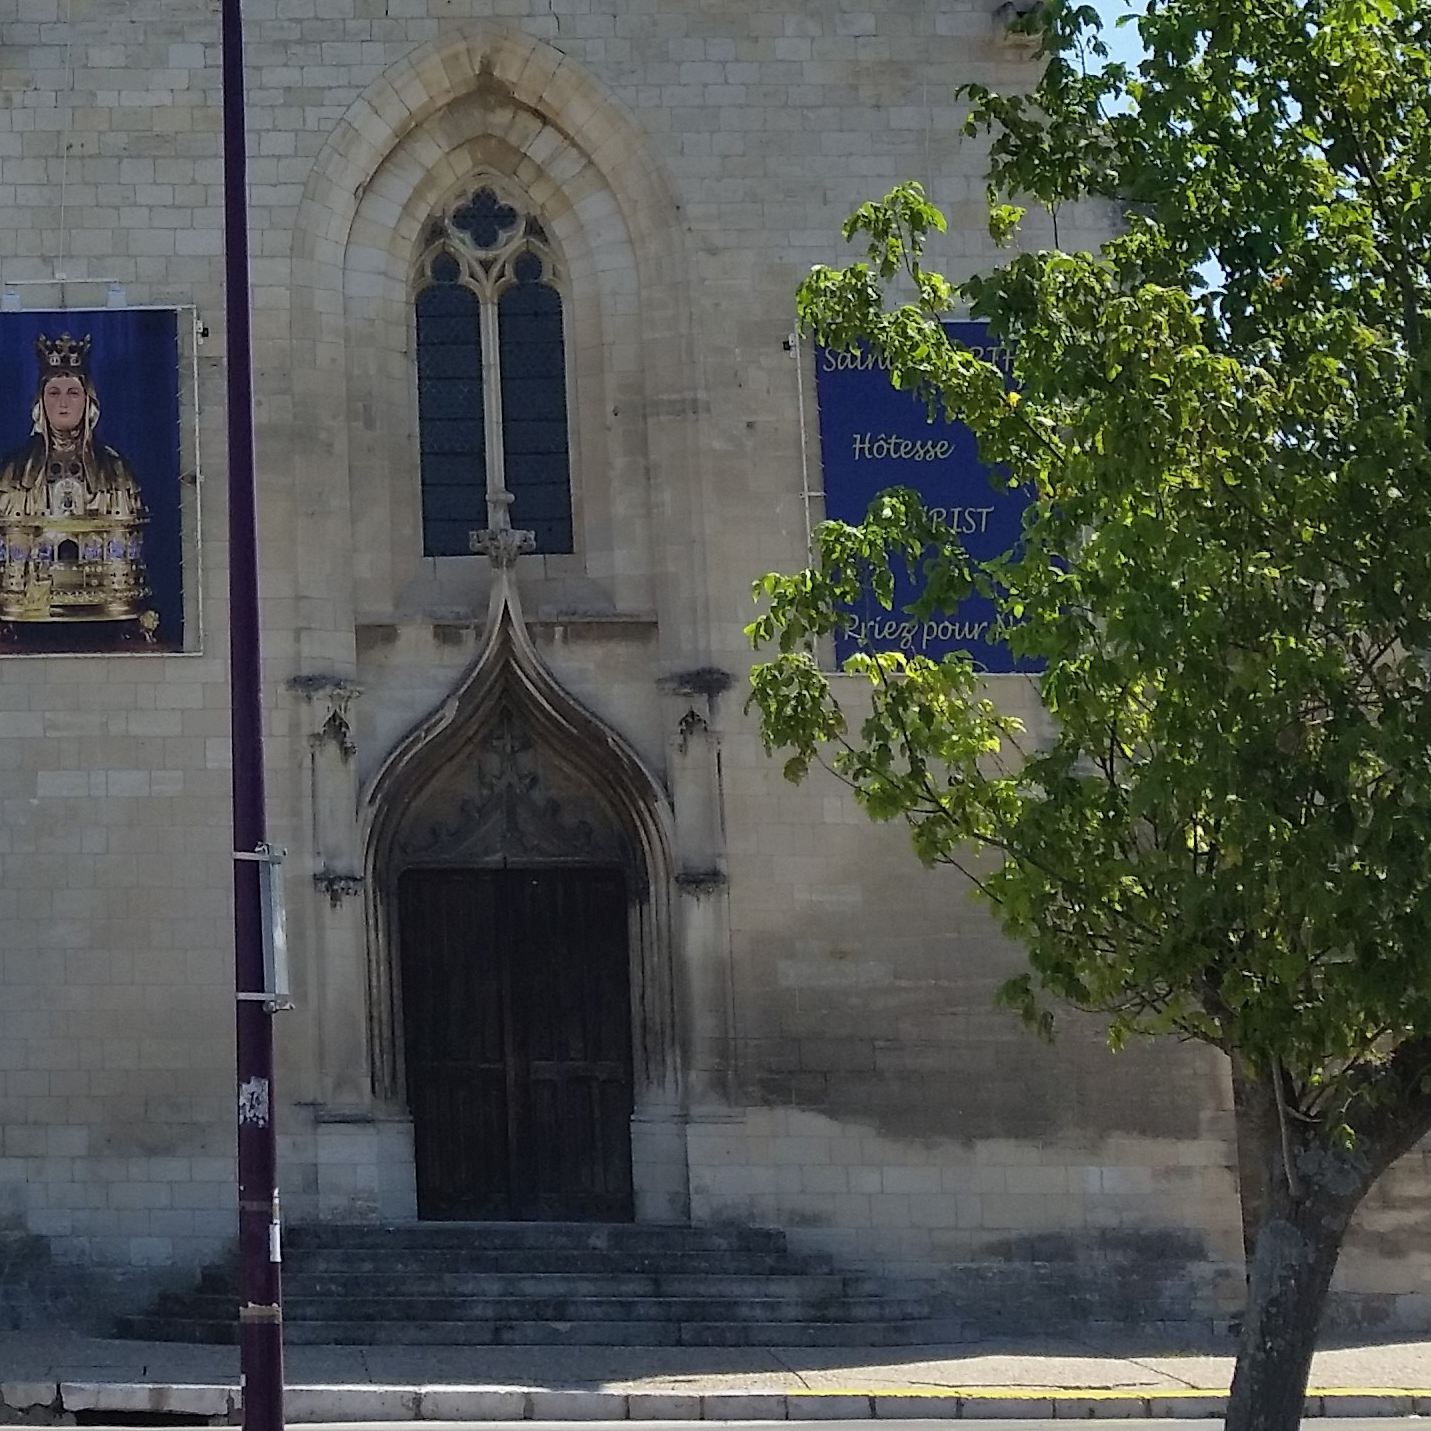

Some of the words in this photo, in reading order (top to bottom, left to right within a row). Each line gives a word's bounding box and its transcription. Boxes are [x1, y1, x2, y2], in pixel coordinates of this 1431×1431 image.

[852, 432, 955, 461] Hôtesse
[926, 505, 995, 534] RIST
[844, 613, 919, 650] Priez
[921, 620, 988, 650] pour
